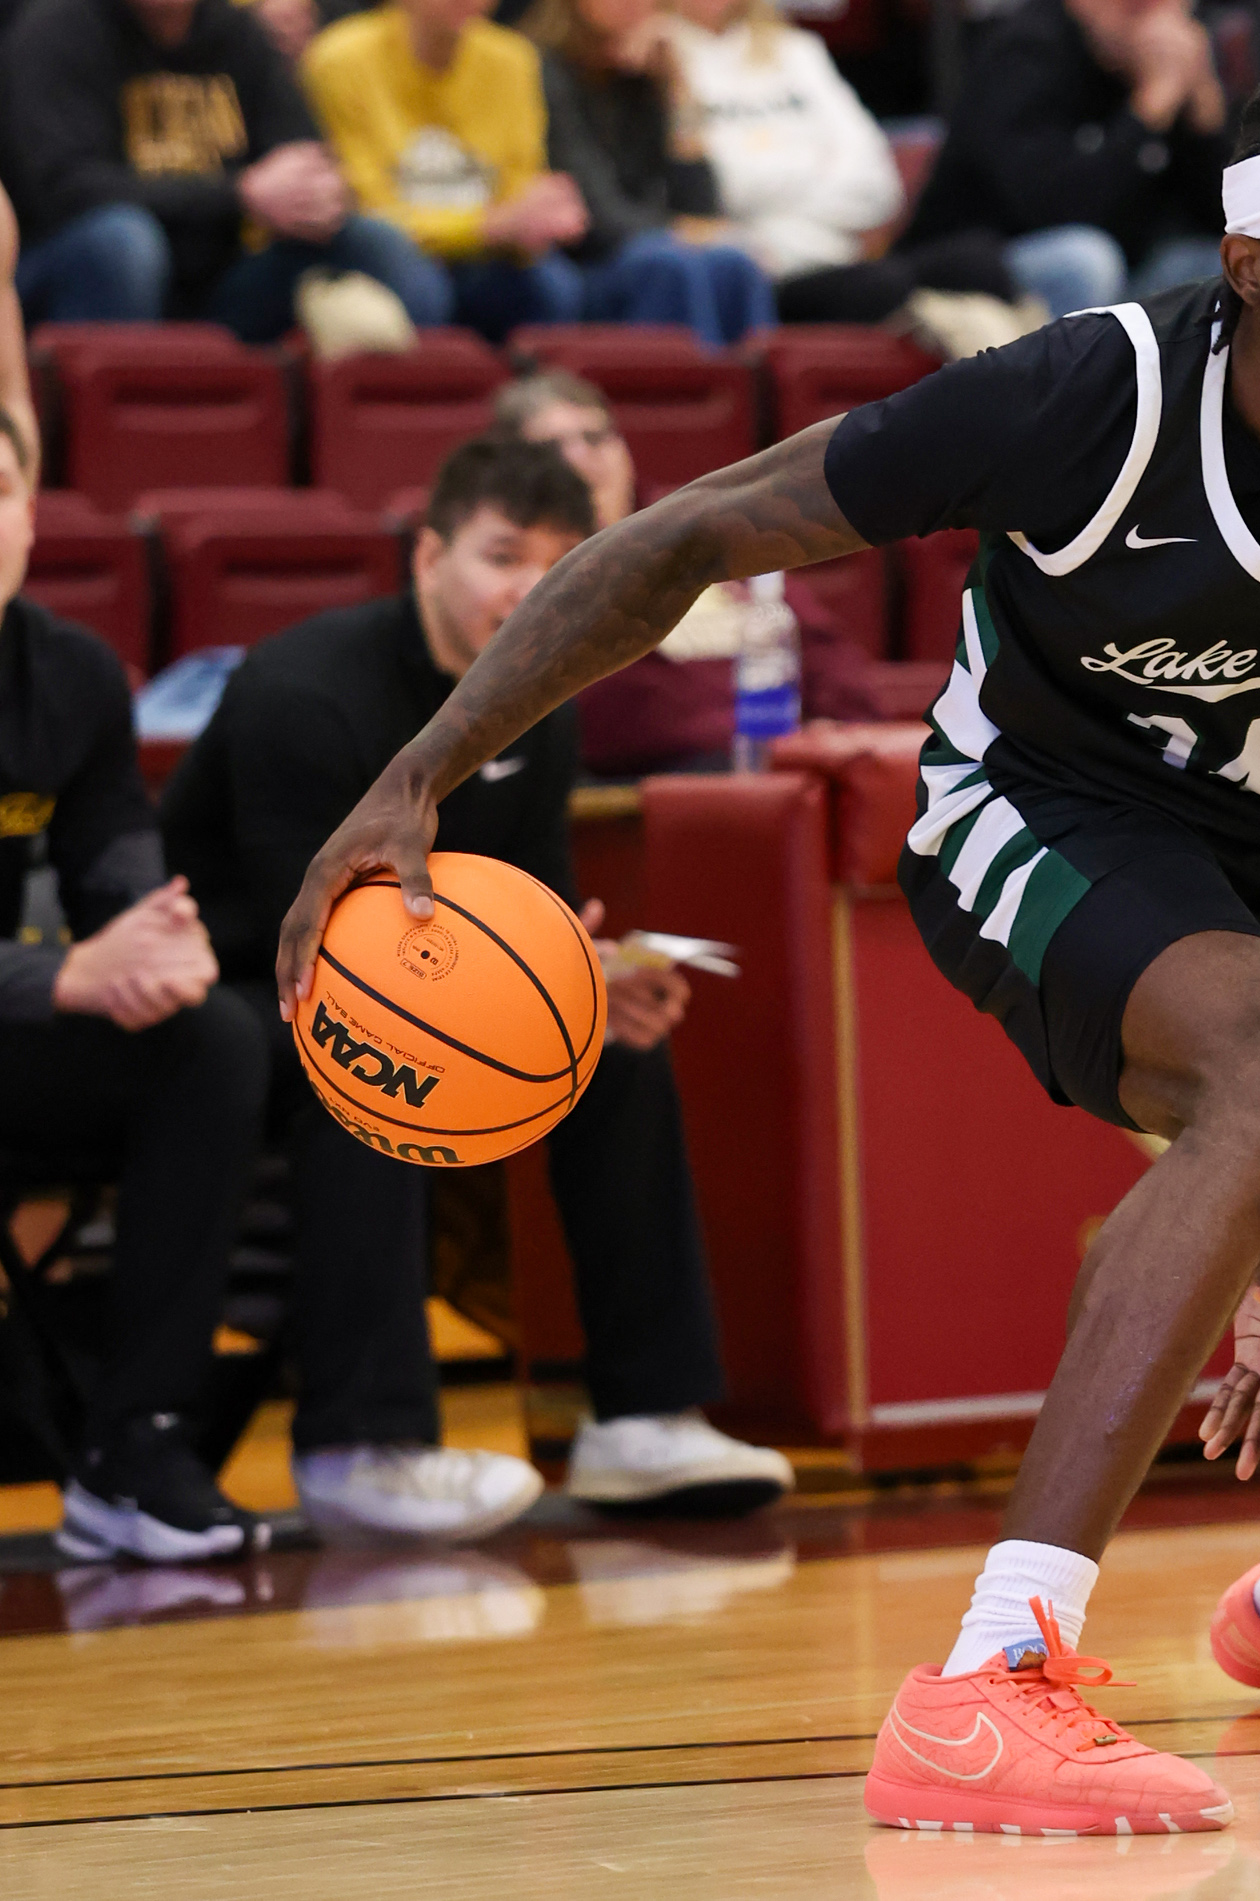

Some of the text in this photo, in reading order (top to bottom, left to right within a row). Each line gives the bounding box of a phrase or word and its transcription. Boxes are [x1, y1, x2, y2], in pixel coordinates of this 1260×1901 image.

[1080, 637, 1258, 685] Lake
[310, 1000, 441, 1109] NCAA
[326, 990, 446, 1074] OFFICIAL GAME BALL
